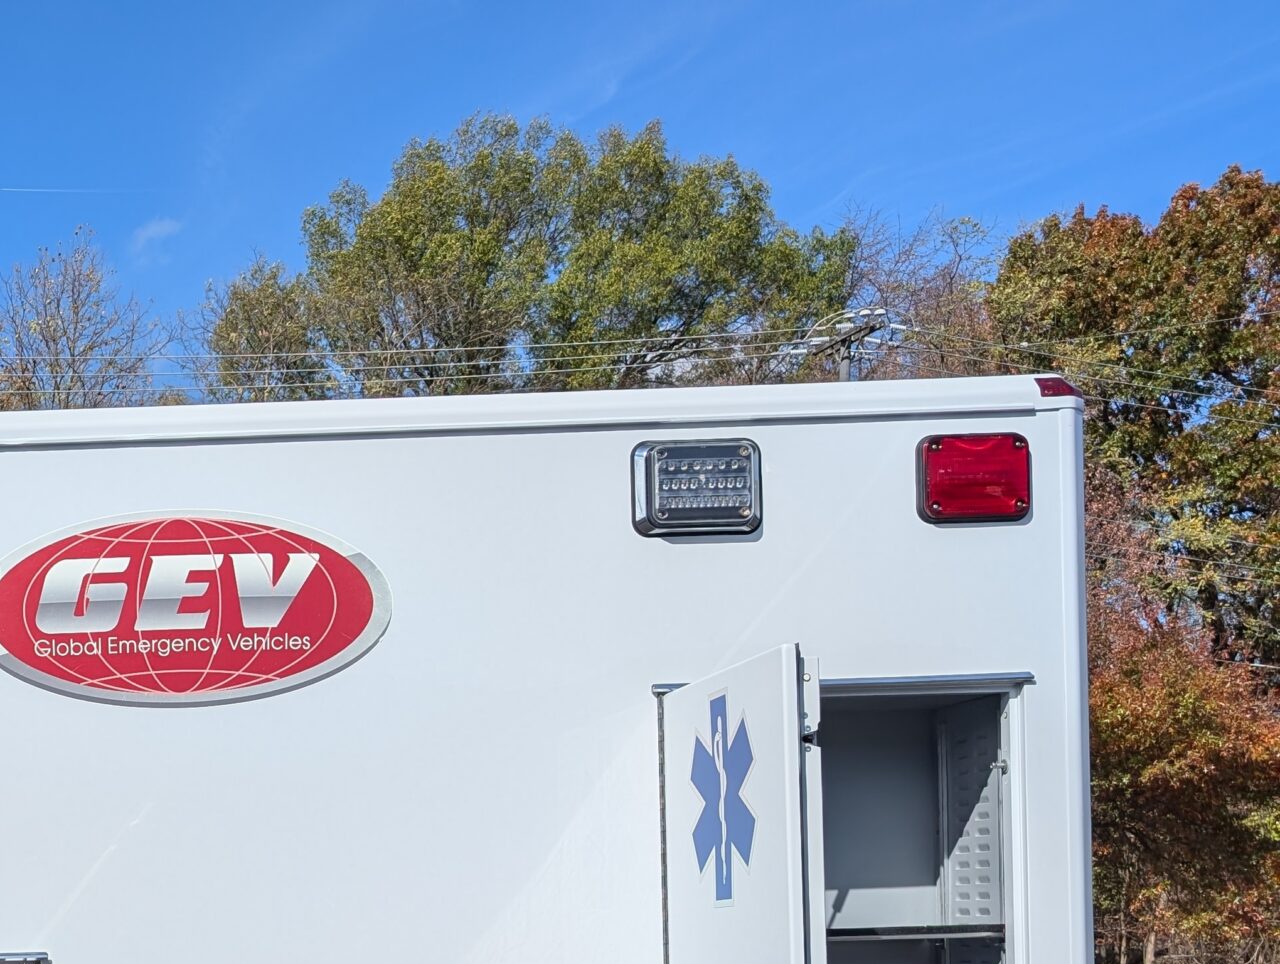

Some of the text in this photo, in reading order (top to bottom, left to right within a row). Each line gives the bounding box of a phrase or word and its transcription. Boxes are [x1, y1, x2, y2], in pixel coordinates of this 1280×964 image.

[35, 552, 320, 635] GEV
[33, 631, 311, 658] Global Emergency Vehicles
